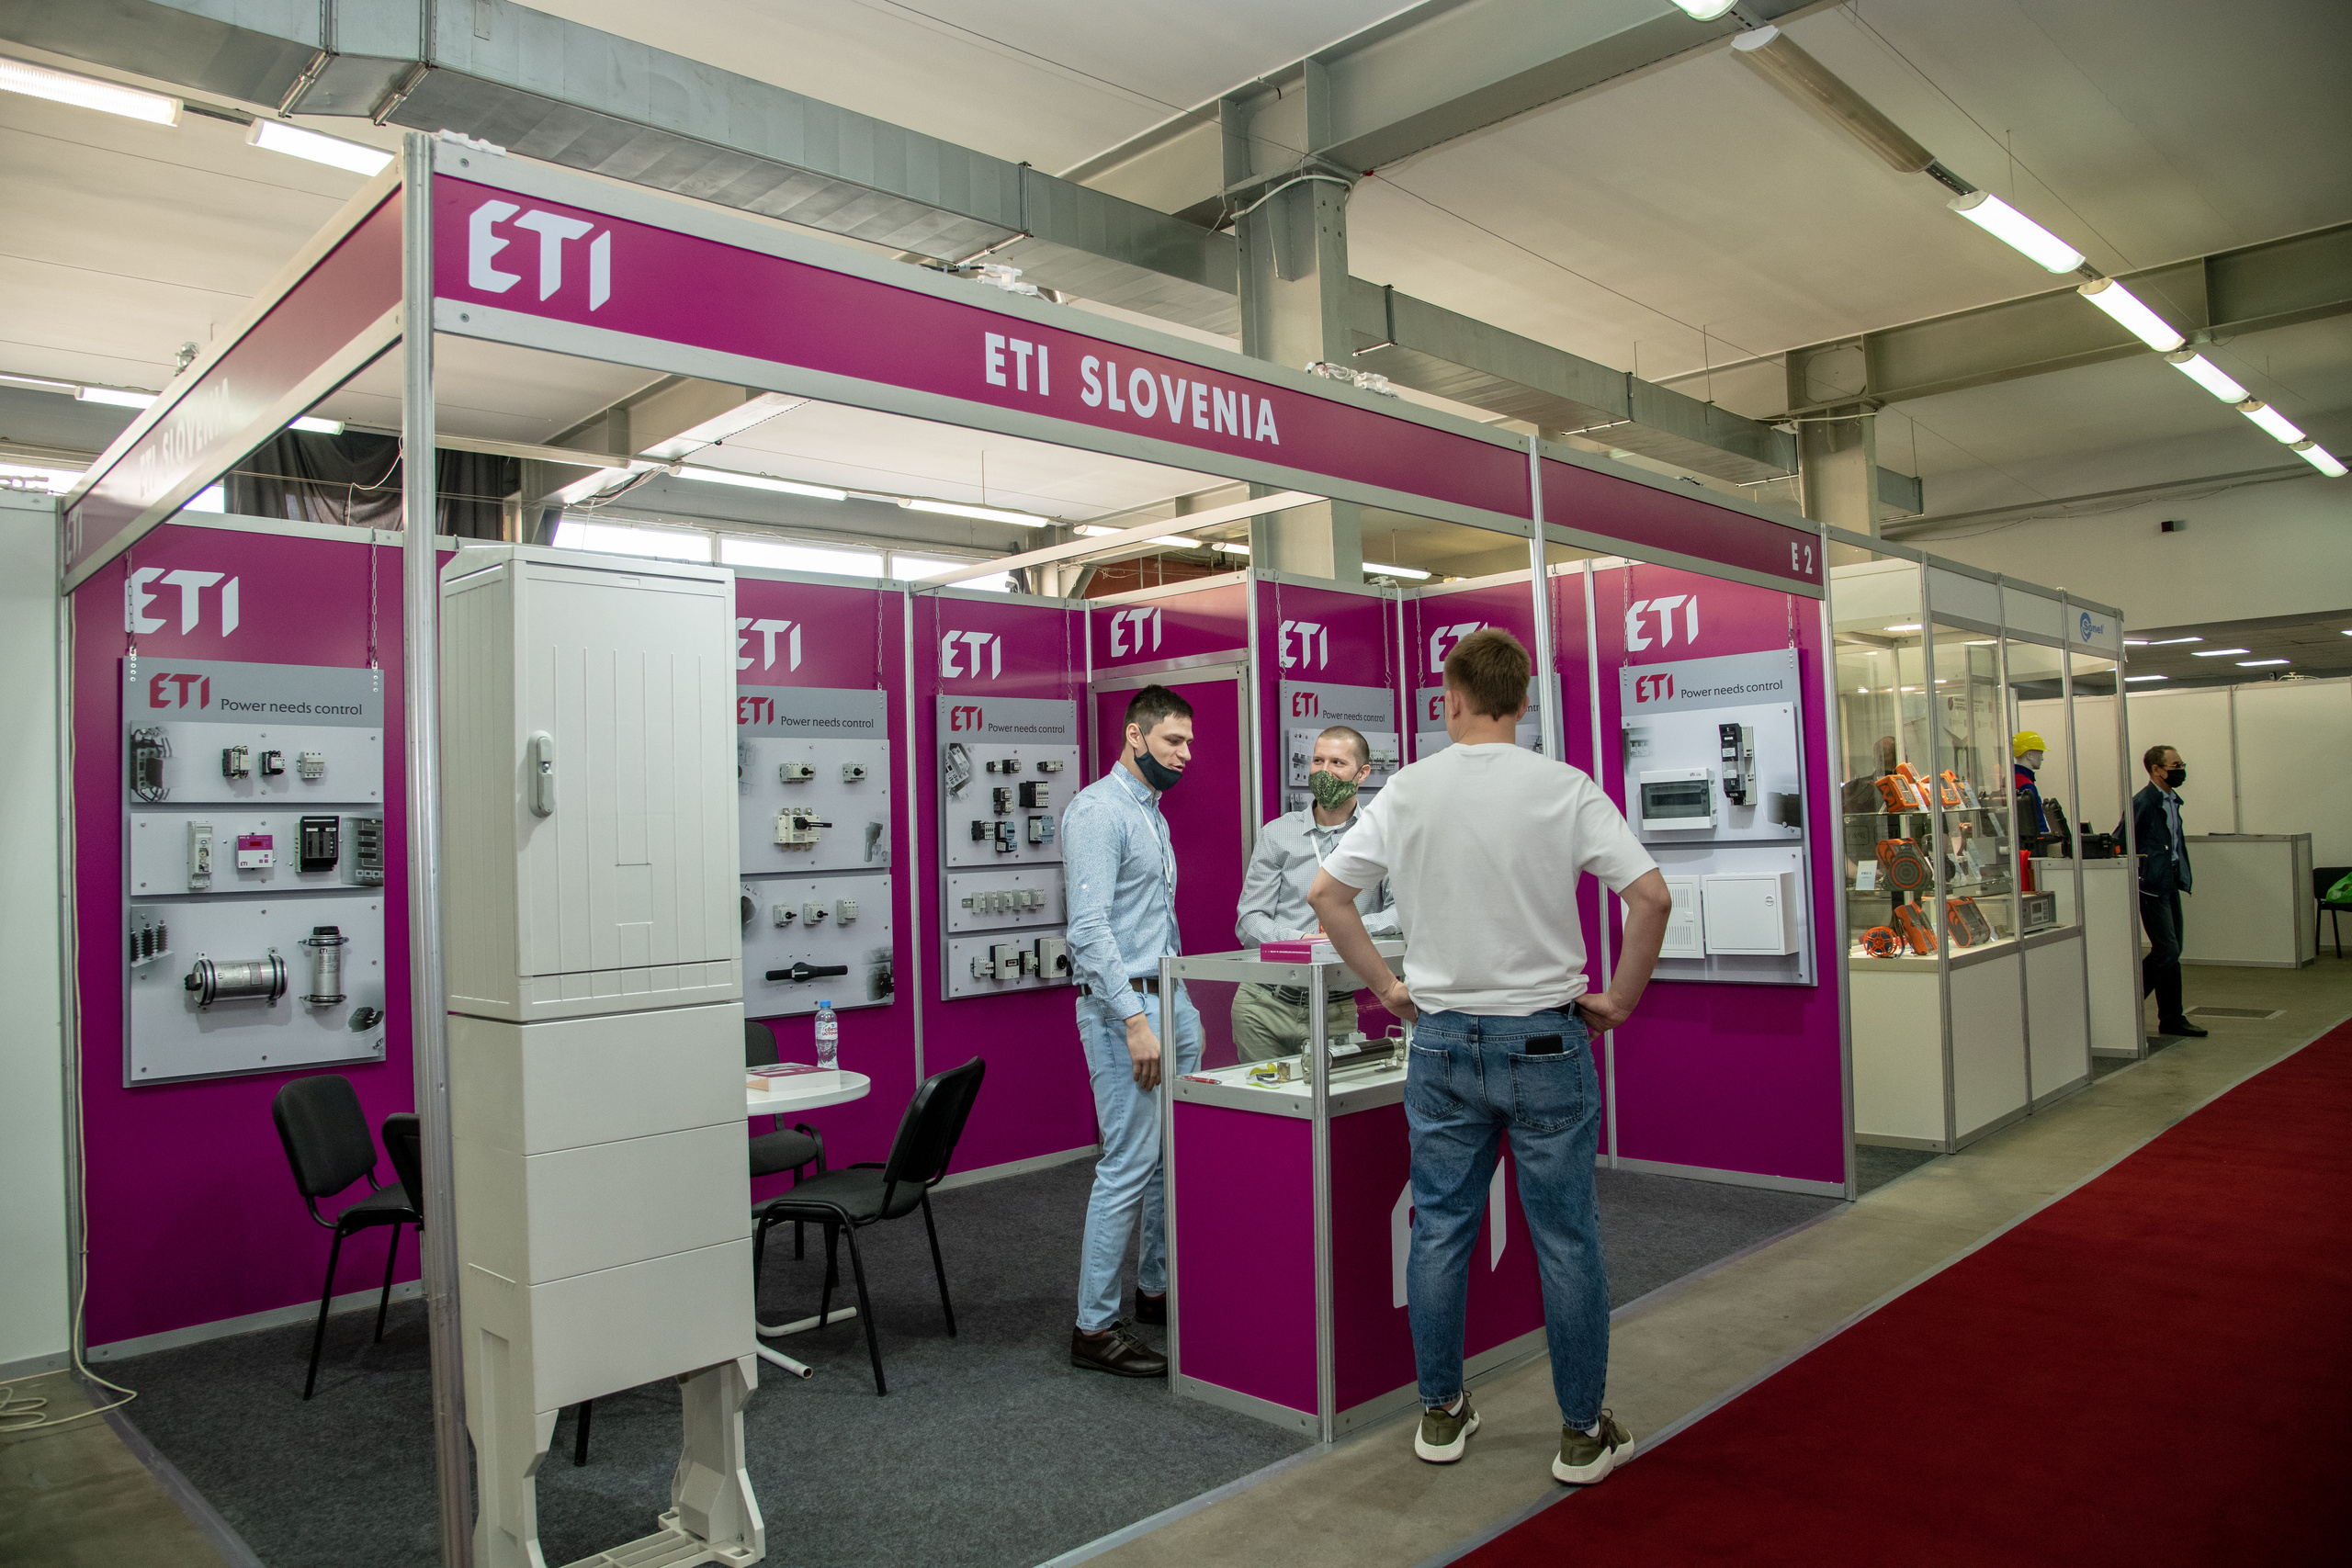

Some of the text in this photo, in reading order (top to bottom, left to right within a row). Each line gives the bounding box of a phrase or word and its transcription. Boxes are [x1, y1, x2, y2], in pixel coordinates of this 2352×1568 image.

[469, 199, 611, 311] ETI
[985, 332, 1280, 446] ETI SLOVENIA
[1792, 542, 1813, 575] E 2
[125, 567, 239, 637] ETI
[1111, 606, 1161, 658] ETI
[1626, 594, 1699, 652] ETI
[2083, 620, 2104, 635] Sonel
[736, 617, 801, 672] ETI
[942, 630, 1001, 680] ETI
[1278, 620, 1328, 671] ETI
[150, 672, 209, 710] ETI
[1292, 692, 1318, 717] ETI
[1635, 673, 1674, 704] ETI
[1680, 680, 1783, 699] Power needs control
[221, 698, 362, 716] Power needs control
[737, 696, 774, 725] ETI
[781, 716, 874, 728] Power needs control
[951, 705, 982, 732] ETI
[1323, 710, 1385, 722] Power needs control
[988, 723, 1065, 734] Power needs control
